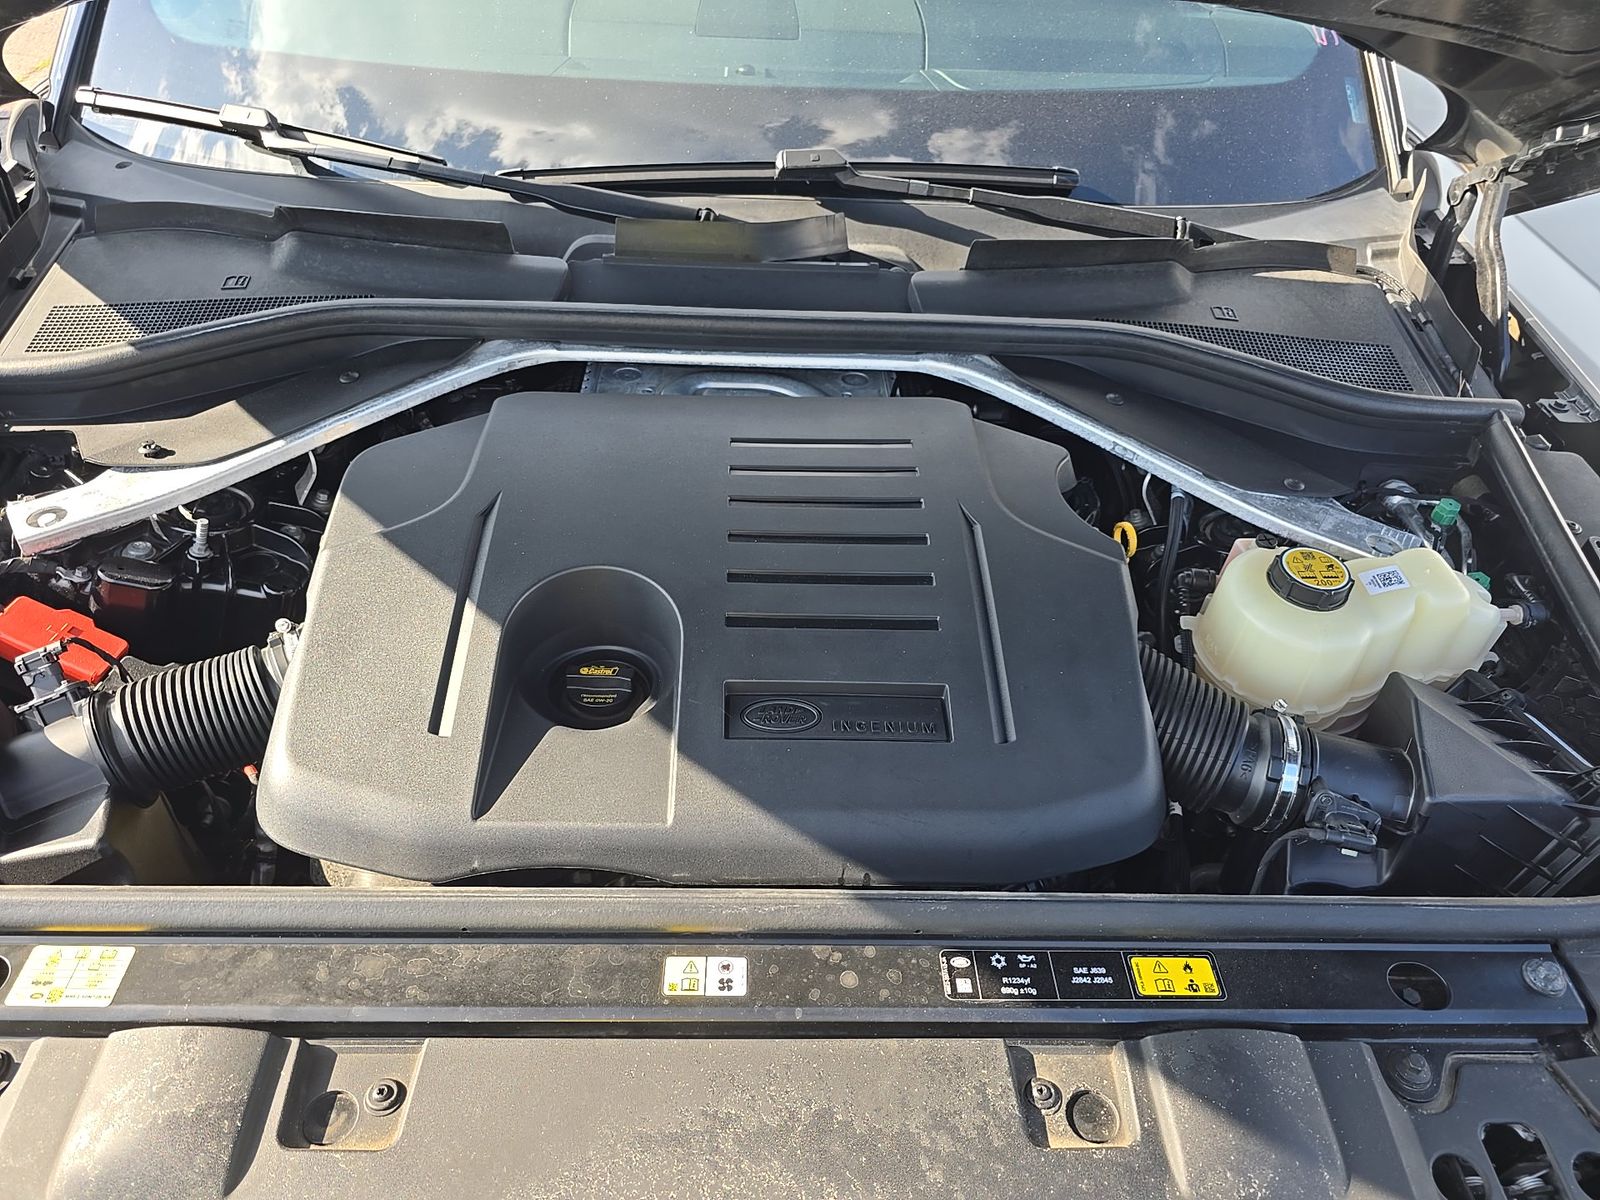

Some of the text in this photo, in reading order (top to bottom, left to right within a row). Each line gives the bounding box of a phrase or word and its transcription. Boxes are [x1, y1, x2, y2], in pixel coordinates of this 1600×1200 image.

[589, 667, 613, 675] Castrol
[831, 719, 937, 735] INGENIUM
[1002, 976, 1031, 986] R1234yf
